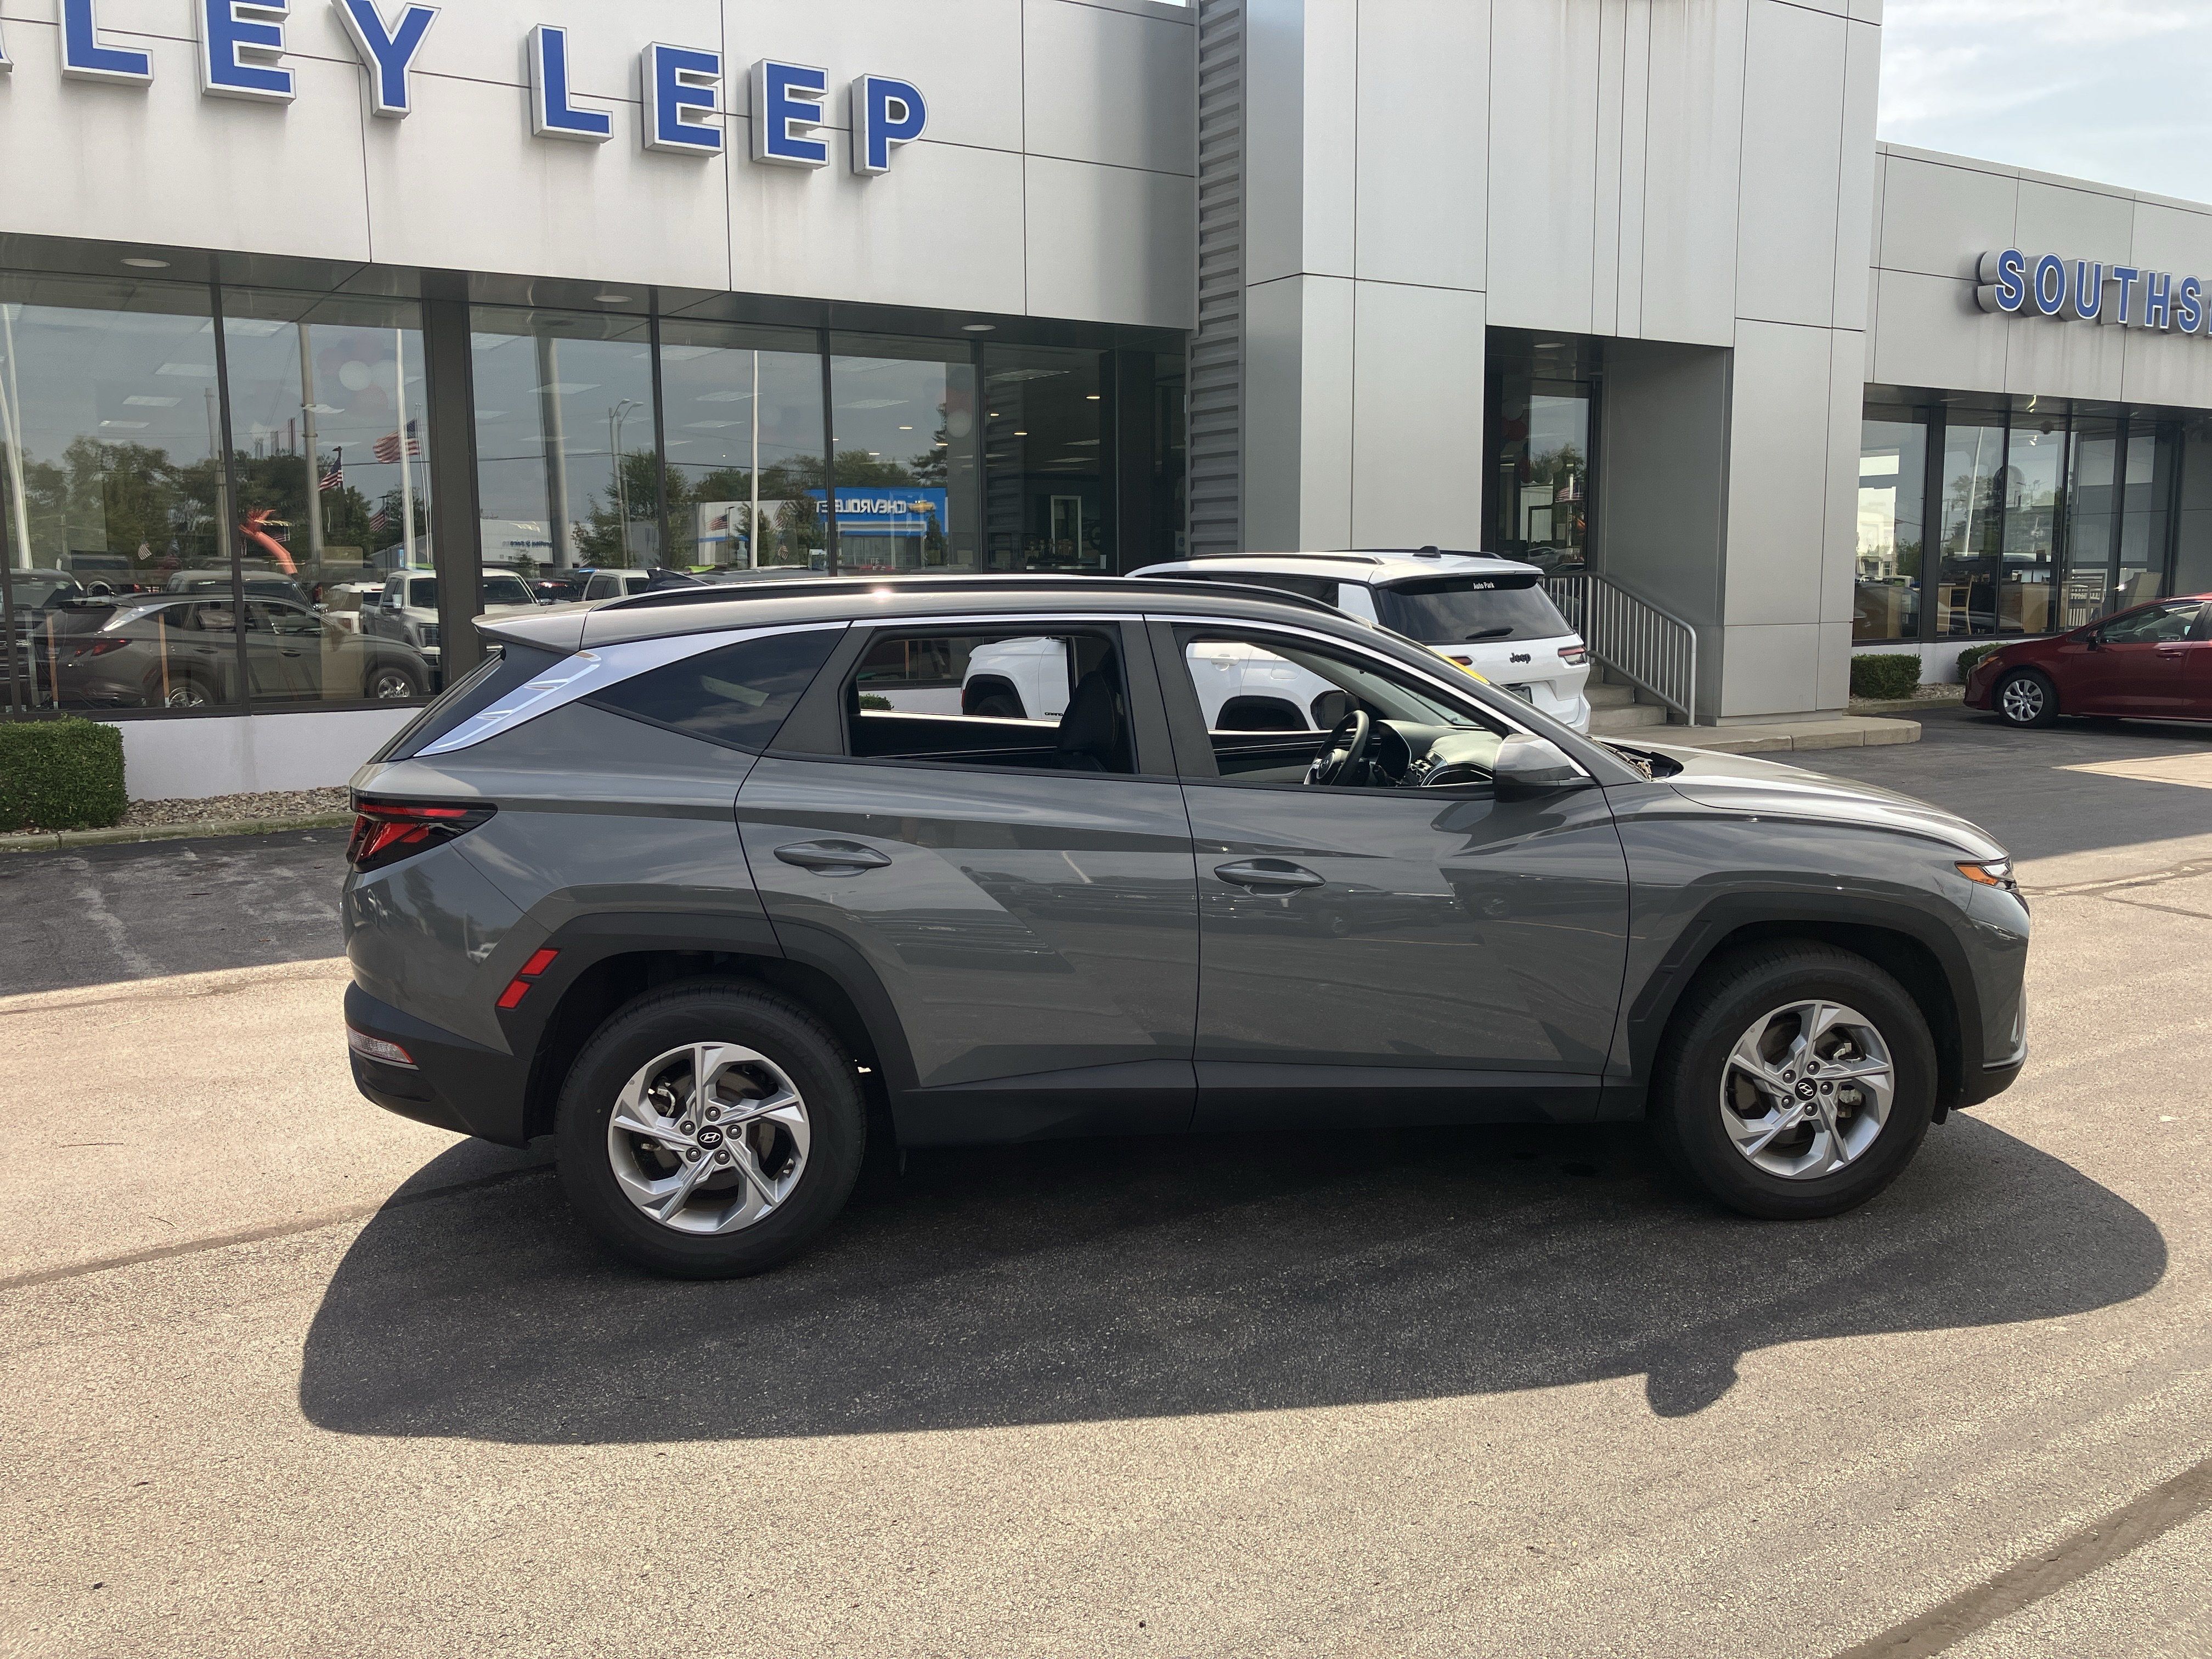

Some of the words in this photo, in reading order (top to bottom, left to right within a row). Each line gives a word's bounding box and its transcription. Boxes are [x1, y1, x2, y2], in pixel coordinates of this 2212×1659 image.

[0, 0, 441, 120] LEY
[528, 23, 928, 177] LEEP
[1977, 246, 2212, 335] SOUTHS
[1509, 652, 1531, 664] Jeep
